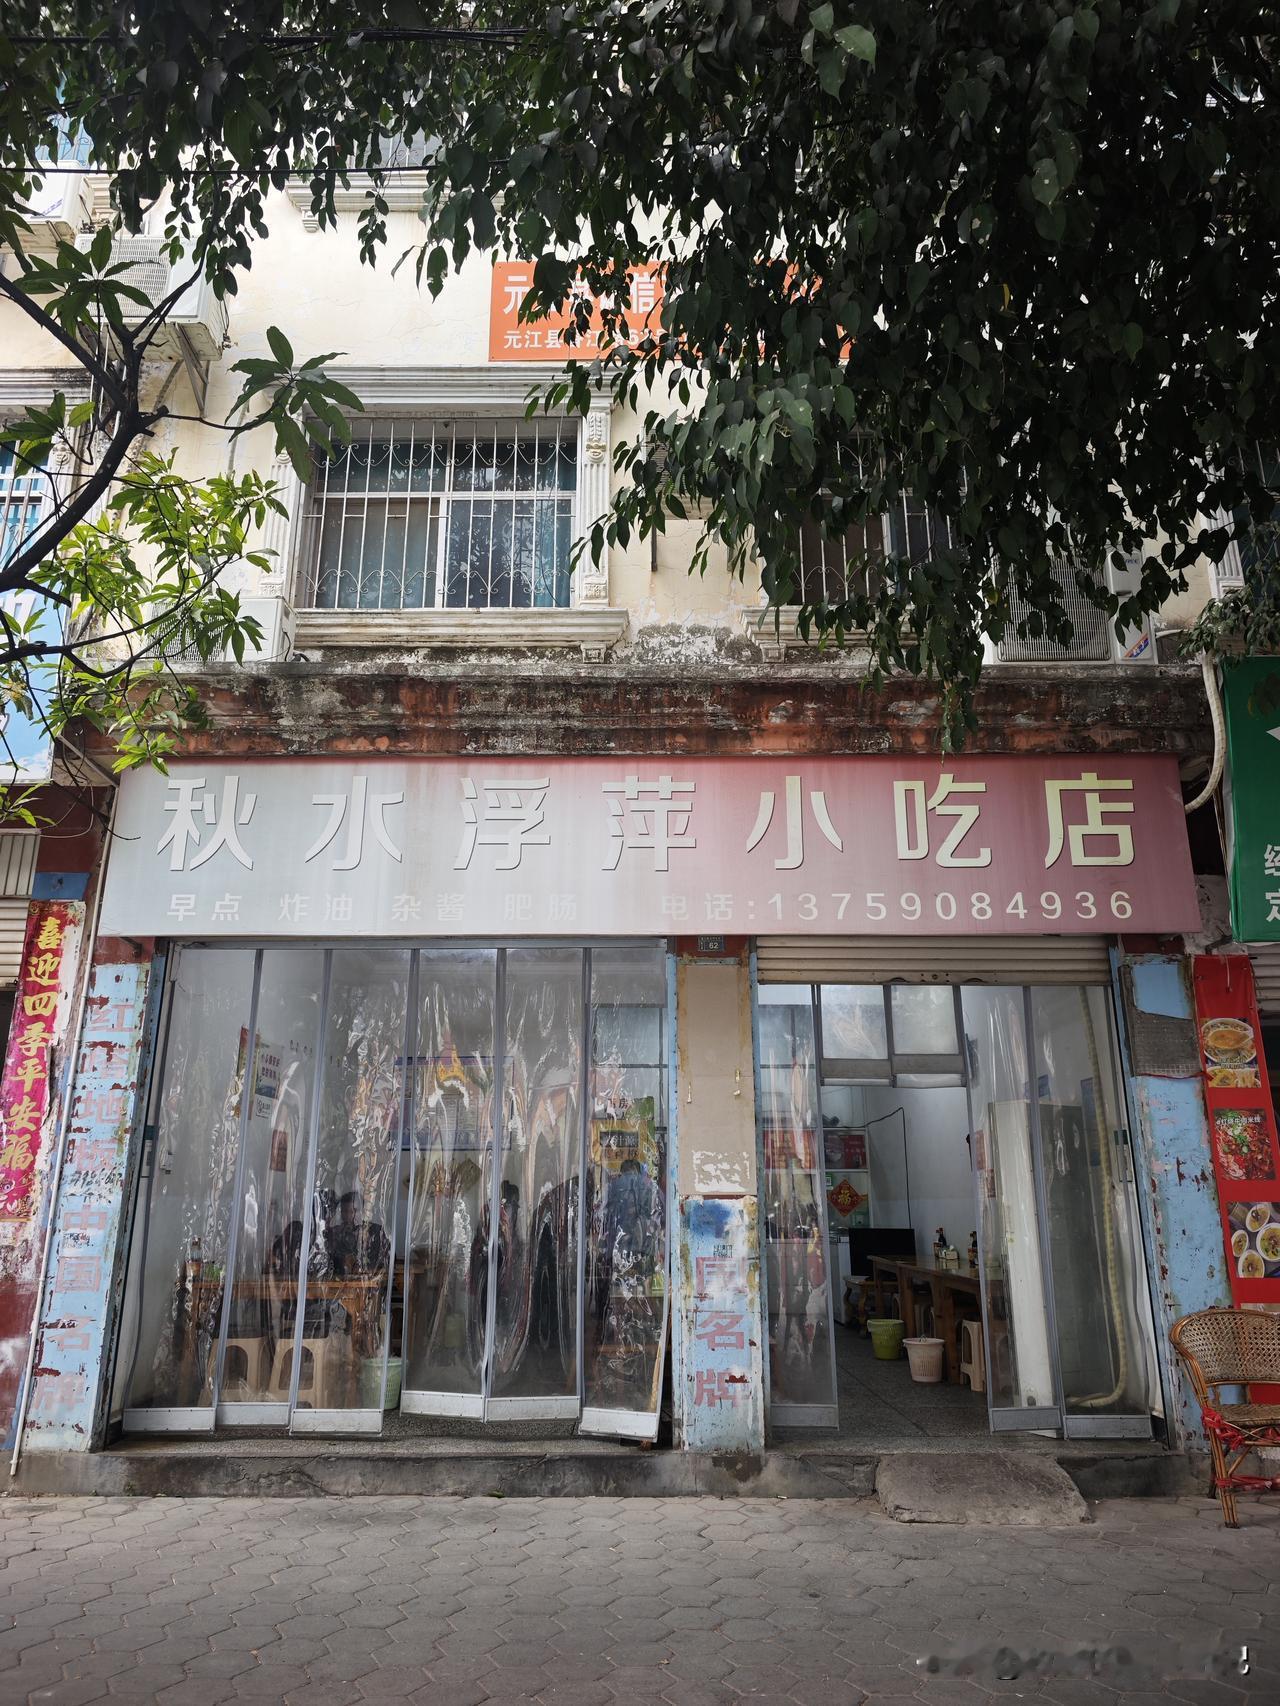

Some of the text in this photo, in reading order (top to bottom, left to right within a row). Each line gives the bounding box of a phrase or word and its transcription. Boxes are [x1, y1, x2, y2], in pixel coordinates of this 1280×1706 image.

[156, 772, 1136, 873] 秋水浮萍小吃店
[167, 892, 242, 921] 早点
[277, 892, 353, 921] 炸油
[391, 892, 466, 921] 杂酱
[503, 892, 577, 921] 肥肠
[0, 915, 65, 1171] 喜迎四季平安福
